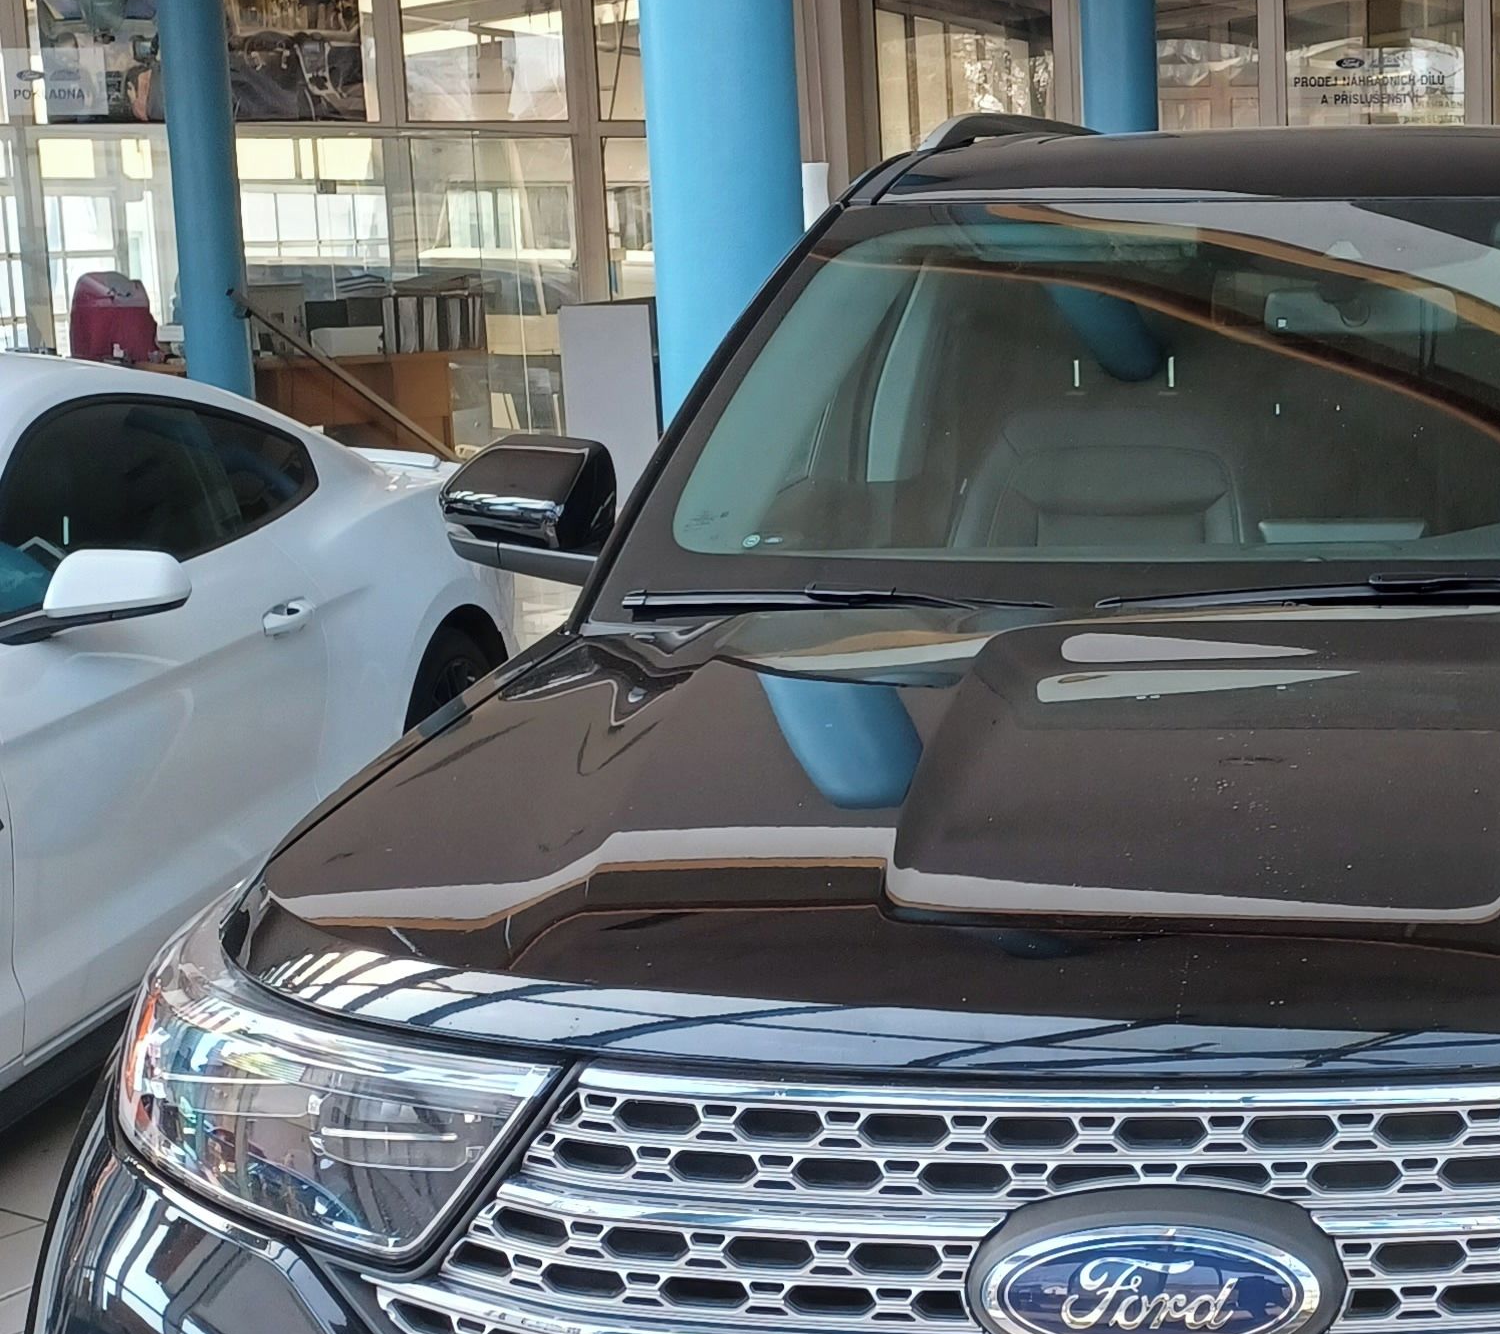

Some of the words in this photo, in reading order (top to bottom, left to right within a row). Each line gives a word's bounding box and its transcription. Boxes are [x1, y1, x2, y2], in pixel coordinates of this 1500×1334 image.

[1294, 76, 1337, 87] PRODEJ
[1321, 94, 1328, 104] A
[1061, 1257, 1239, 1330] Ford
